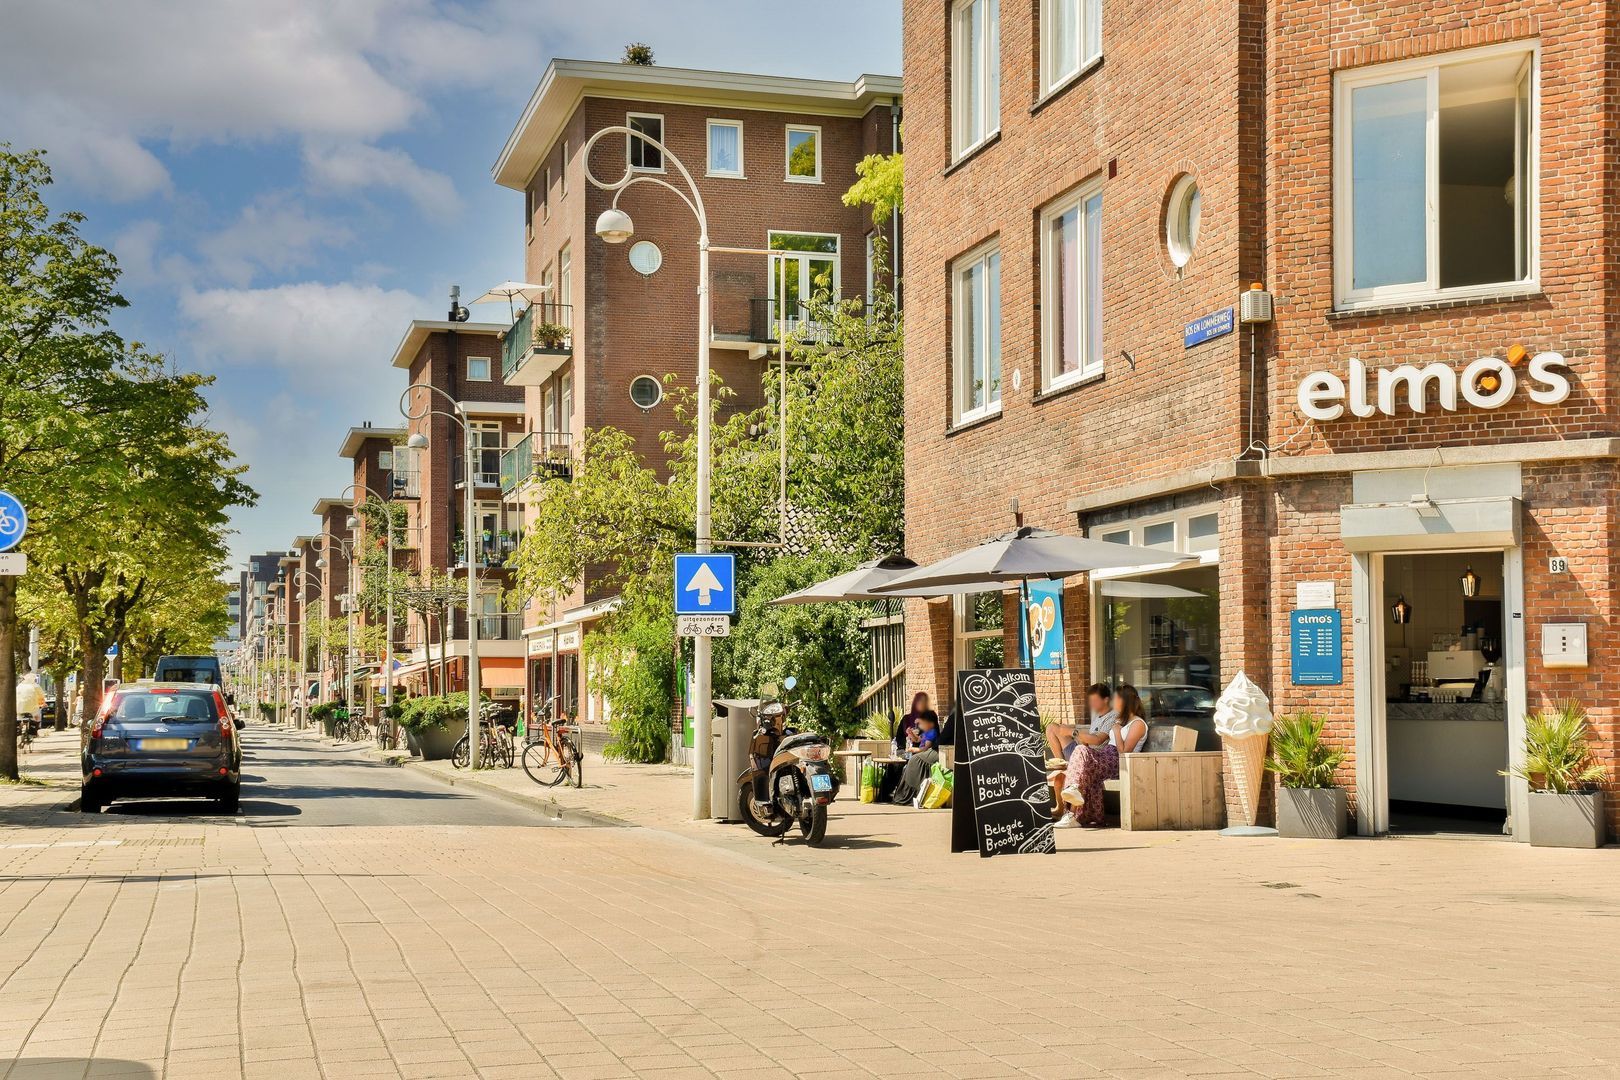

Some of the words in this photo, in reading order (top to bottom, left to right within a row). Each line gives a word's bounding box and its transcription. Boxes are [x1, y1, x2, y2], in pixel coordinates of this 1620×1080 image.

[1185, 326, 1193, 336] BOS
[1193, 322, 1201, 333] EN
[1297, 343, 1571, 421] elmo's
[1551, 560, 1565, 571] 89
[1298, 615, 1332, 624] elmo's
[989, 673, 1030, 690] Welkom
[972, 743, 989, 756] Met
[976, 772, 1019, 788] Healthy
[978, 783, 1011, 801] Bowls
[984, 818, 1024, 836] Belegde
[985, 832, 1025, 851] Broodjes
